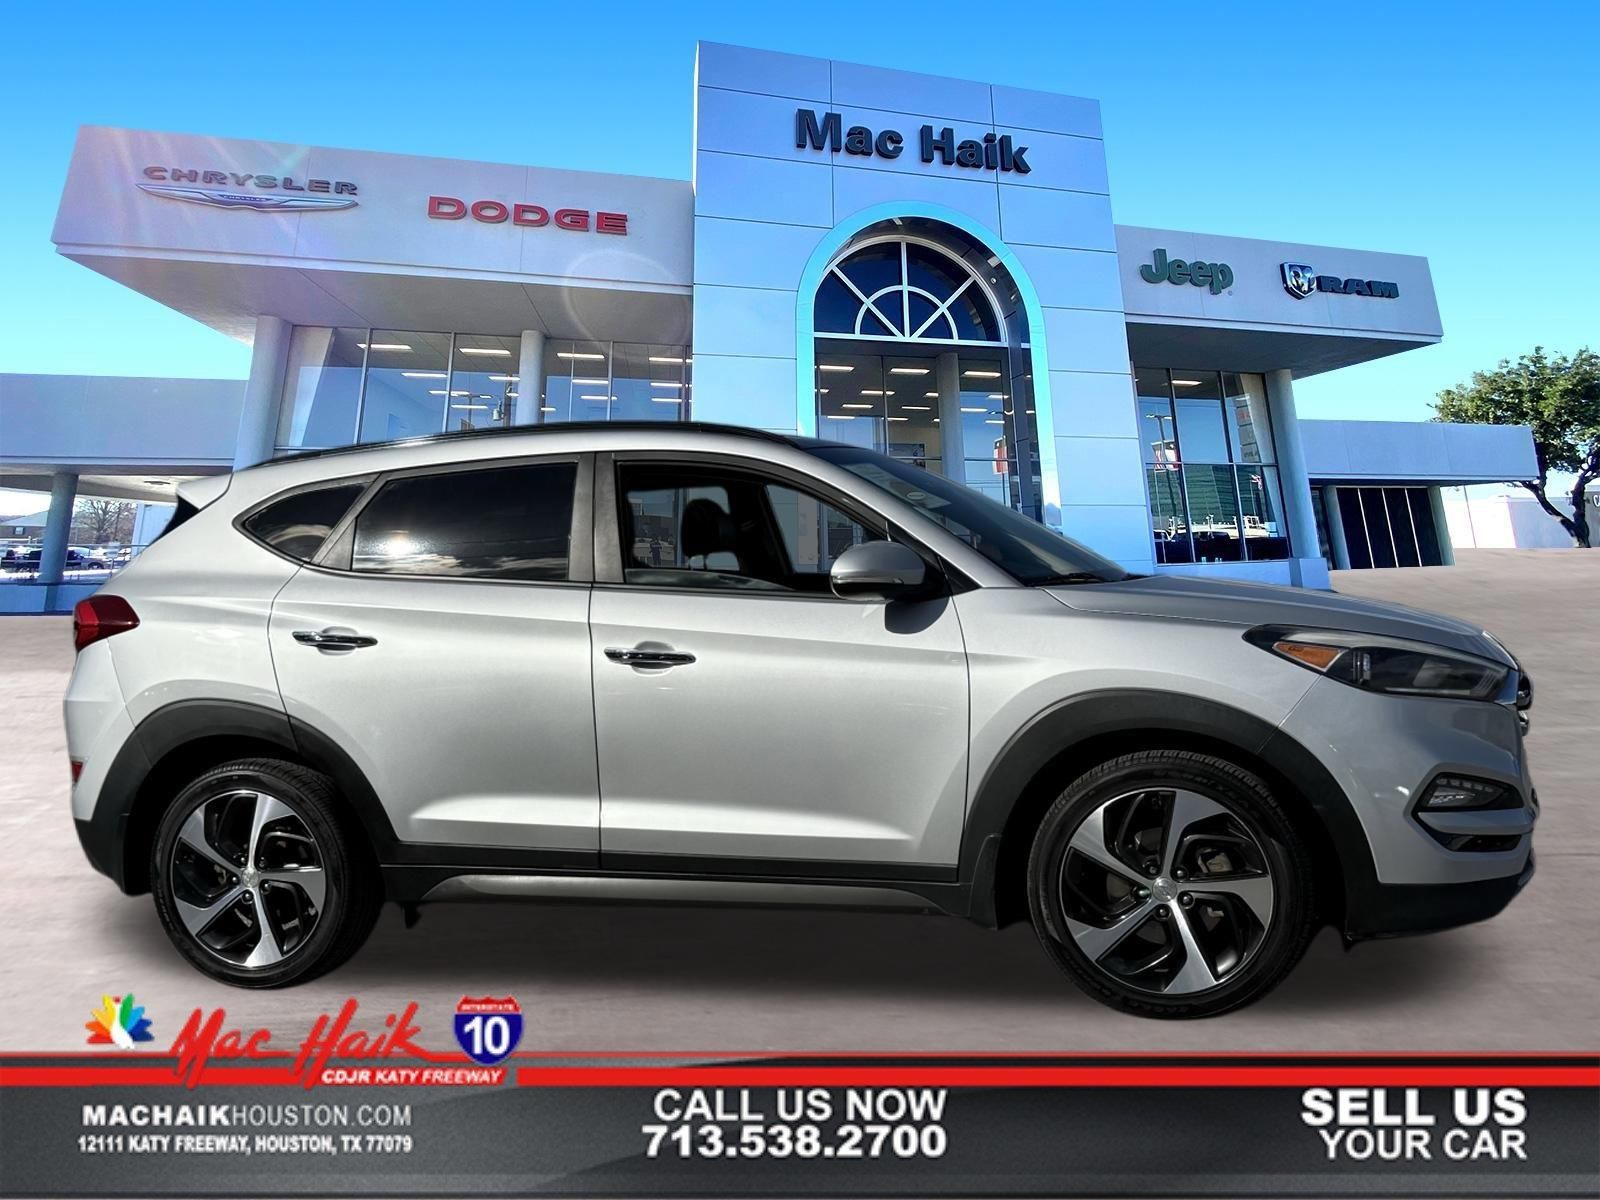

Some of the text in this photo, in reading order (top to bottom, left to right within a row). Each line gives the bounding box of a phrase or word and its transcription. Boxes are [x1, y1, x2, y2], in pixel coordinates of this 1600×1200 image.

[795, 108, 1032, 174] Mac Haik
[143, 166, 358, 196] CHRYSLER
[428, 196, 628, 236] DODGE
[1140, 248, 1234, 295] Jeep
[1315, 275, 1400, 299] RAM
